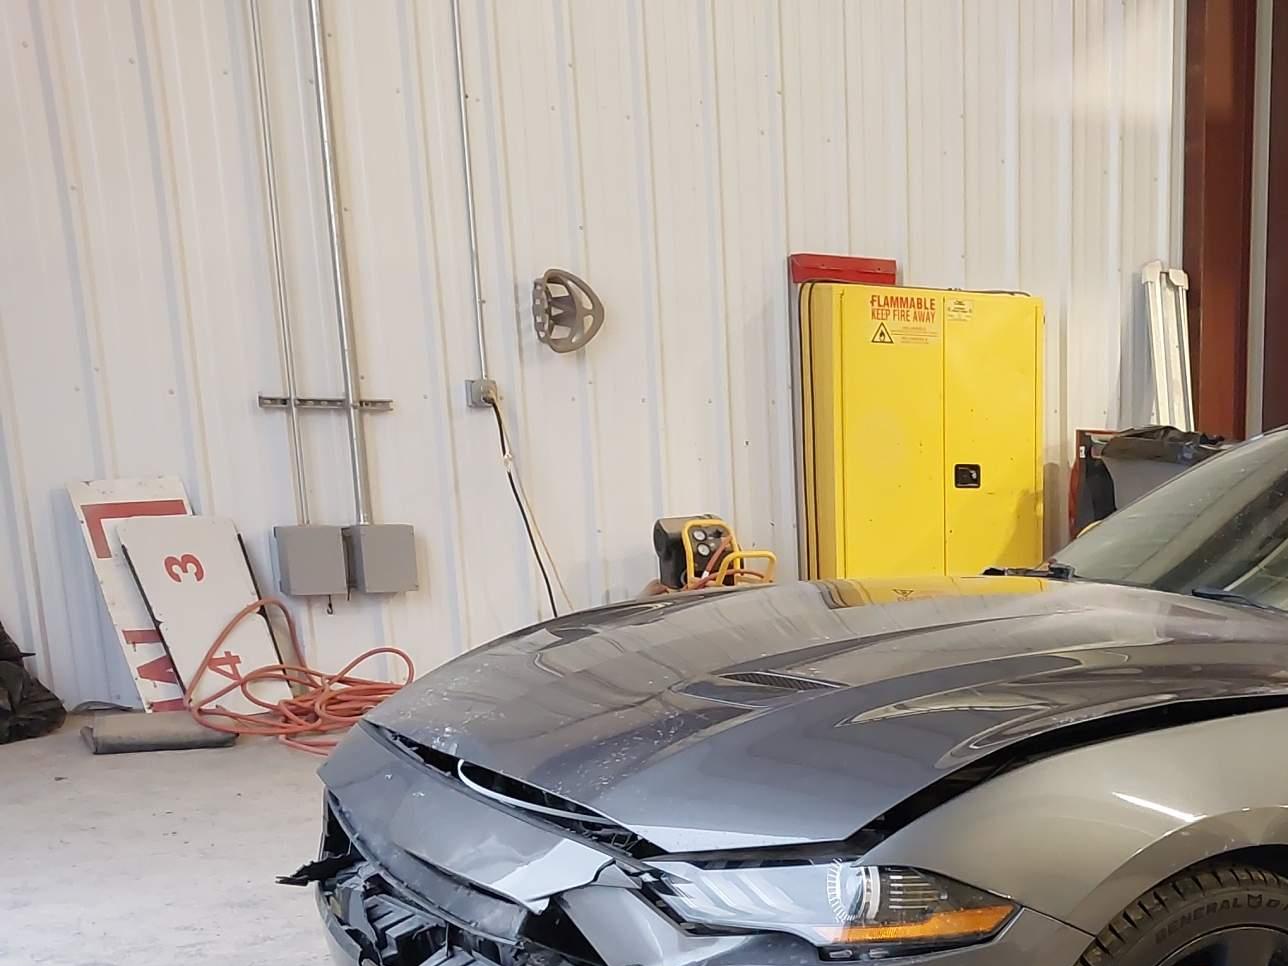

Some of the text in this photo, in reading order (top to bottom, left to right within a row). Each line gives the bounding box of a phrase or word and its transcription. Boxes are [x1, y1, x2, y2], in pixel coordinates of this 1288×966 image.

[870, 295, 936, 310] FLAMMABLE
[871, 308, 936, 324] KEEP FIRE AWAY
[164, 554, 205, 582] 3
[1155, 897, 1243, 944] GENERAL
